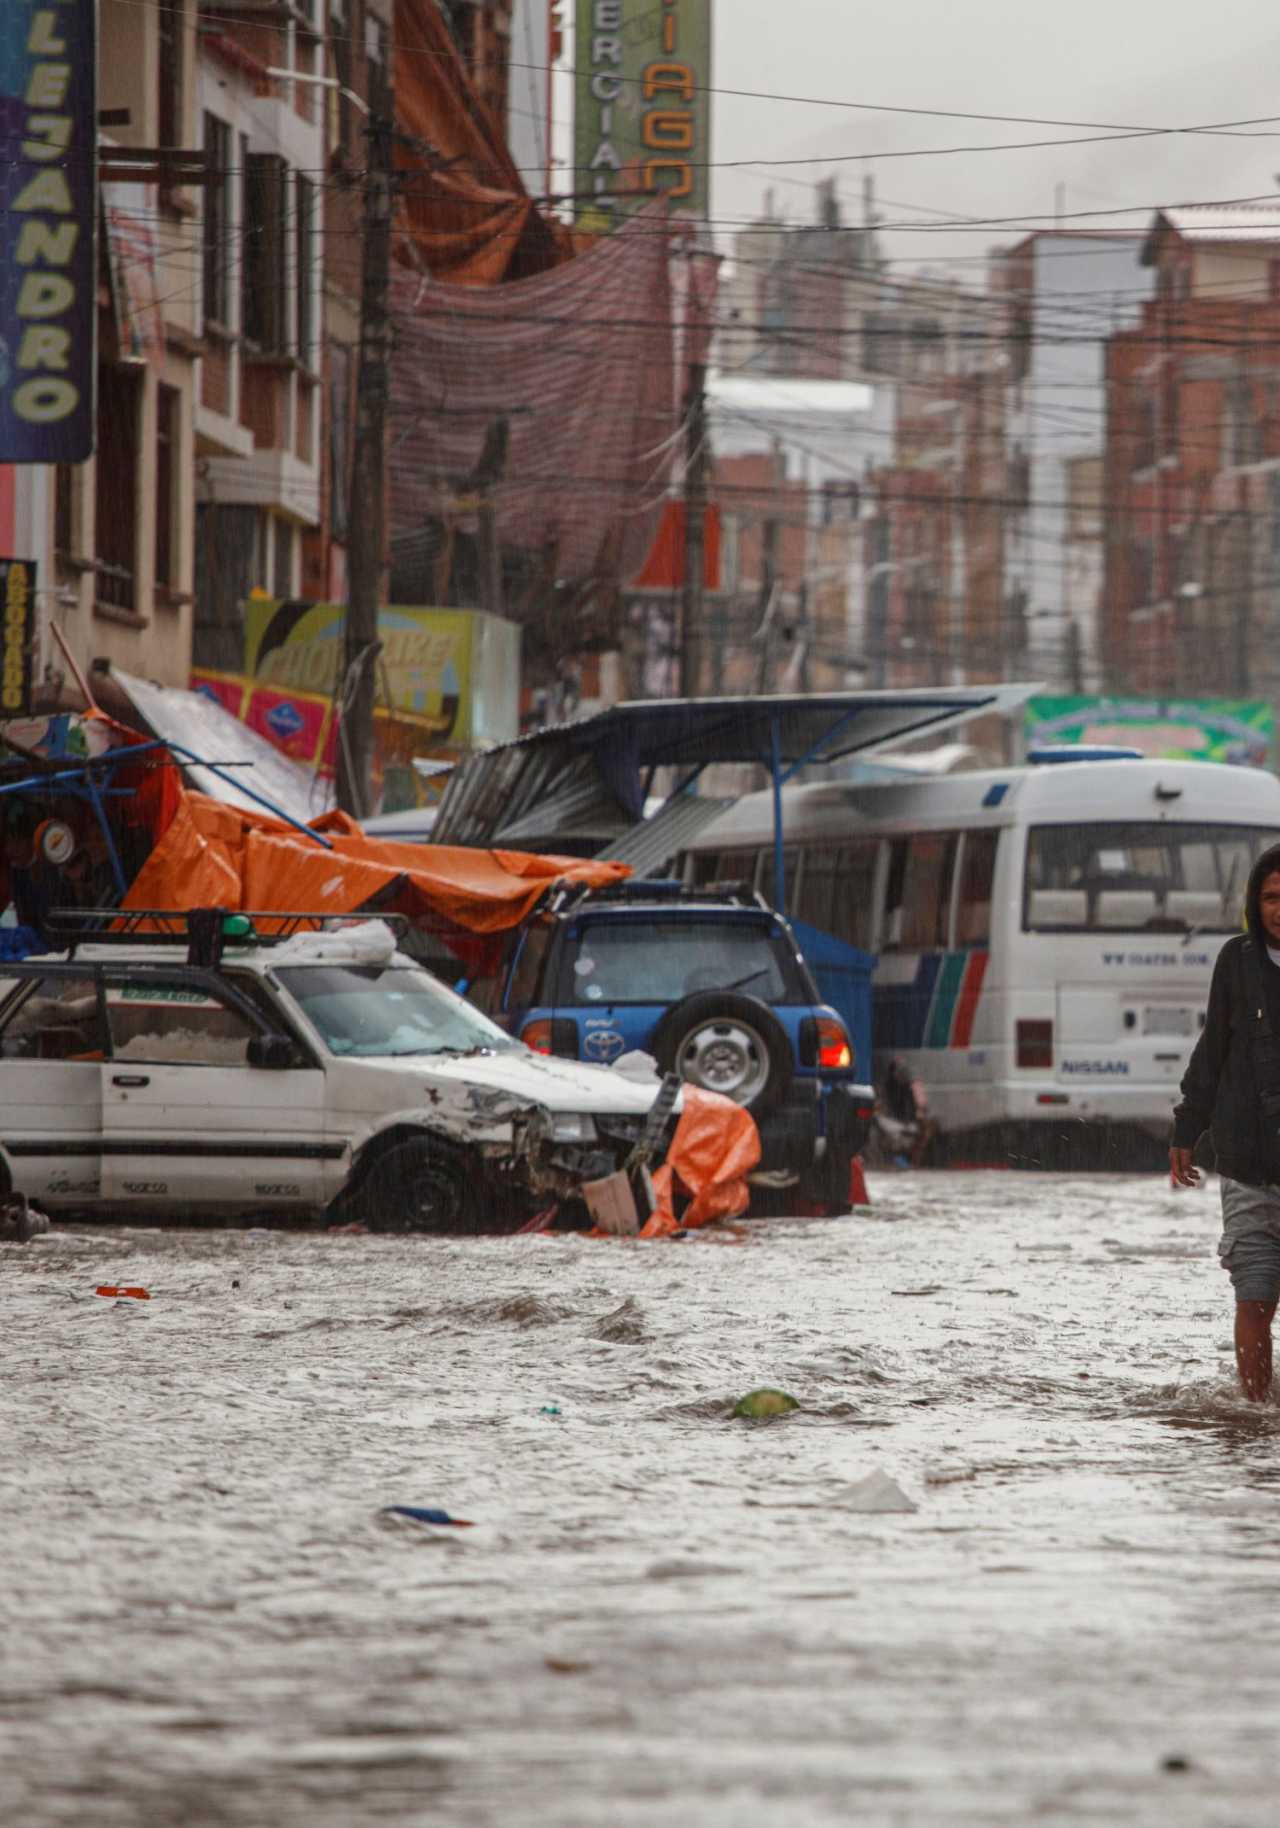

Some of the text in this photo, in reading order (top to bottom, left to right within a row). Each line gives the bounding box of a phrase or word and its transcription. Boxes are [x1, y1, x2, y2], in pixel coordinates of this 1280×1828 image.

[643, 0, 696, 198] IAGO
[10, 0, 80, 423] LEJANDRO
[1061, 1059, 1129, 1075] NISSAN
